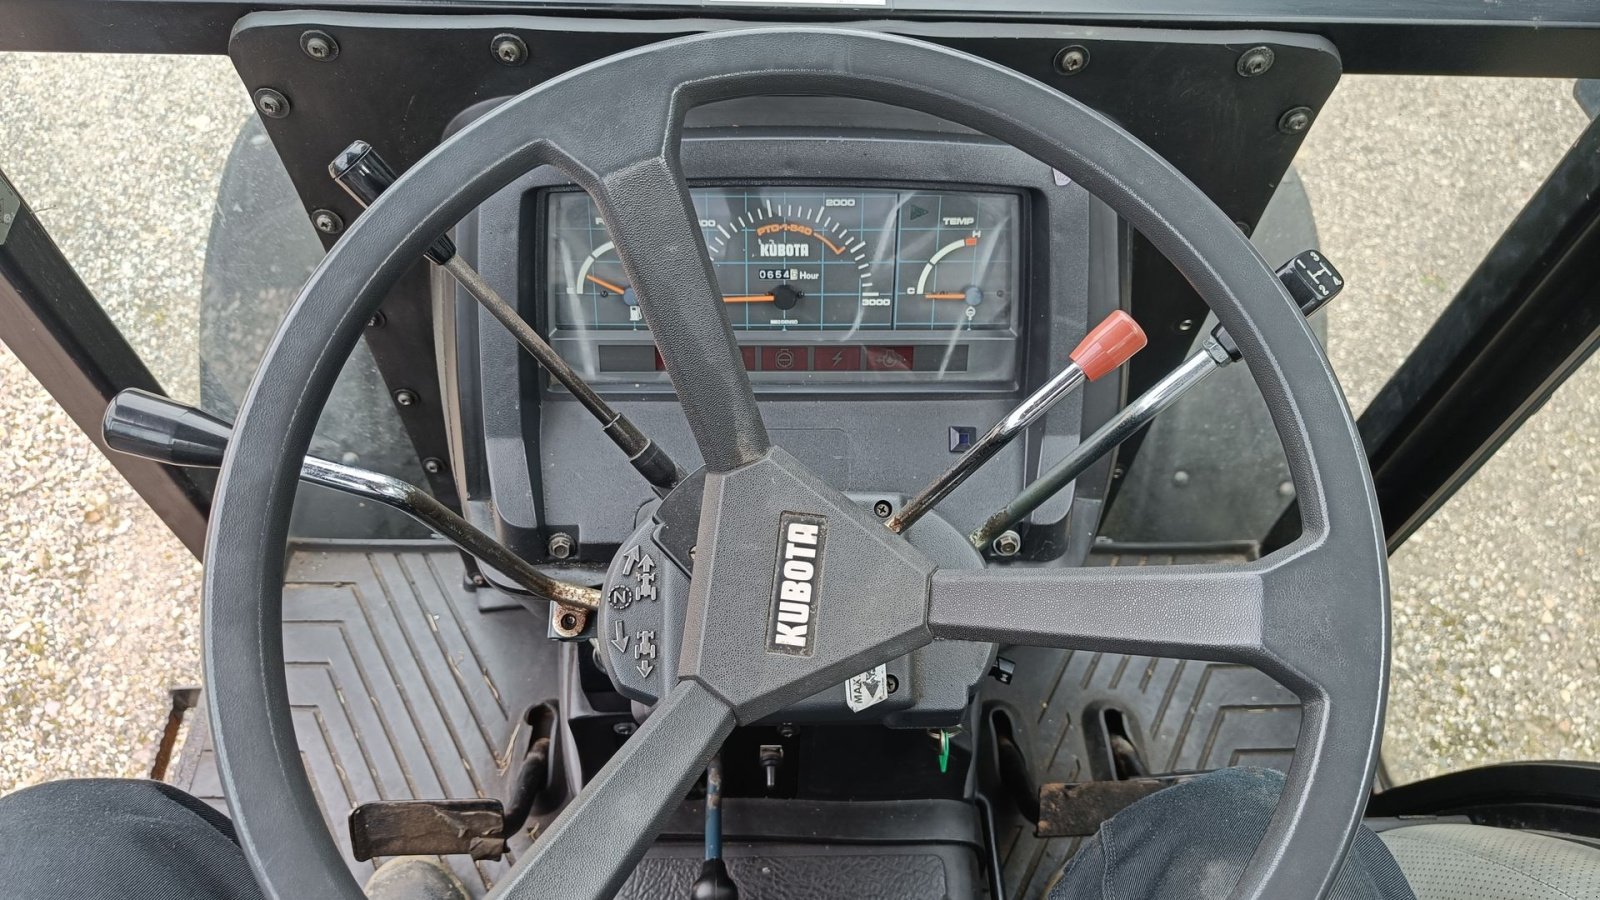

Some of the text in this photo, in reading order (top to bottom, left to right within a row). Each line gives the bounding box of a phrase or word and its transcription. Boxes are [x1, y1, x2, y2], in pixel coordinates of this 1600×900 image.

[943, 217, 975, 226] TEMP
[972, 230, 981, 238] H
[760, 243, 809, 257] KUBOTA
[1310, 251, 1320, 262] 3
[799, 271, 819, 280] Hour
[1332, 276, 1342, 286] 4
[1319, 284, 1329, 296] 2
[775, 523, 819, 647] KUBOTA
[613, 590, 627, 604] N
